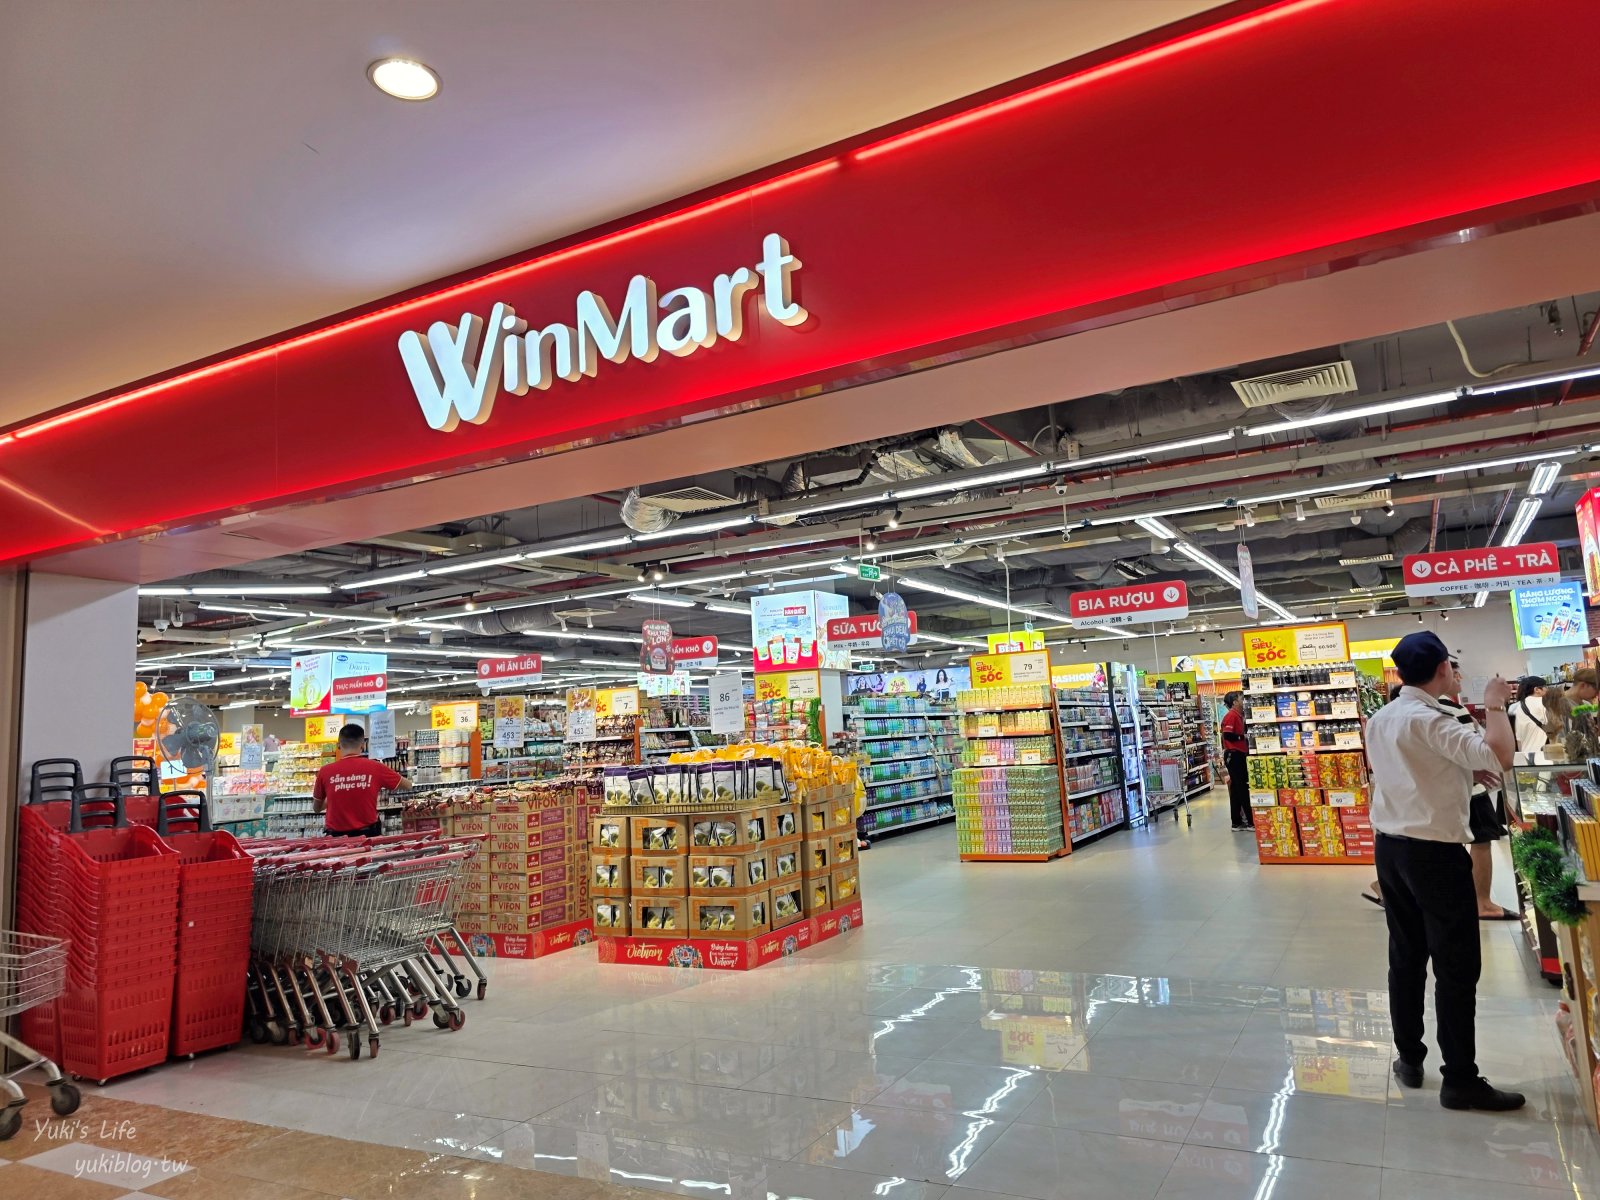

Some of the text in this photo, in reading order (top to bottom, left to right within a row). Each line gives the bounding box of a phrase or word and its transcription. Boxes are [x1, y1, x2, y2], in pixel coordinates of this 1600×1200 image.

[398, 233, 808, 432] WinMart
[1434, 558, 1460, 575] CÀ
[1464, 554, 1498, 573] PHÊ
[1516, 550, 1552, 568] TRÀ
[1078, 592, 1154, 612] BIA RƯỢU
[832, 622, 857, 635] SỮA
[686, 644, 700, 653] KHÔ
[1252, 642, 1272, 650] SIÊU
[1256, 646, 1286, 662] SỐC
[496, 663, 506, 672] MÌ
[507, 661, 518, 672] ĂN
[980, 670, 1003, 684] SỐC
[720, 692, 730, 702] 86
[762, 686, 782, 699] SỐC
[596, 704, 606, 712] ỐC
[346, 774, 366, 782] sàng
[334, 782, 355, 792] phục
[497, 922, 519, 930] VIFON
[627, 943, 662, 961] Vietnam
